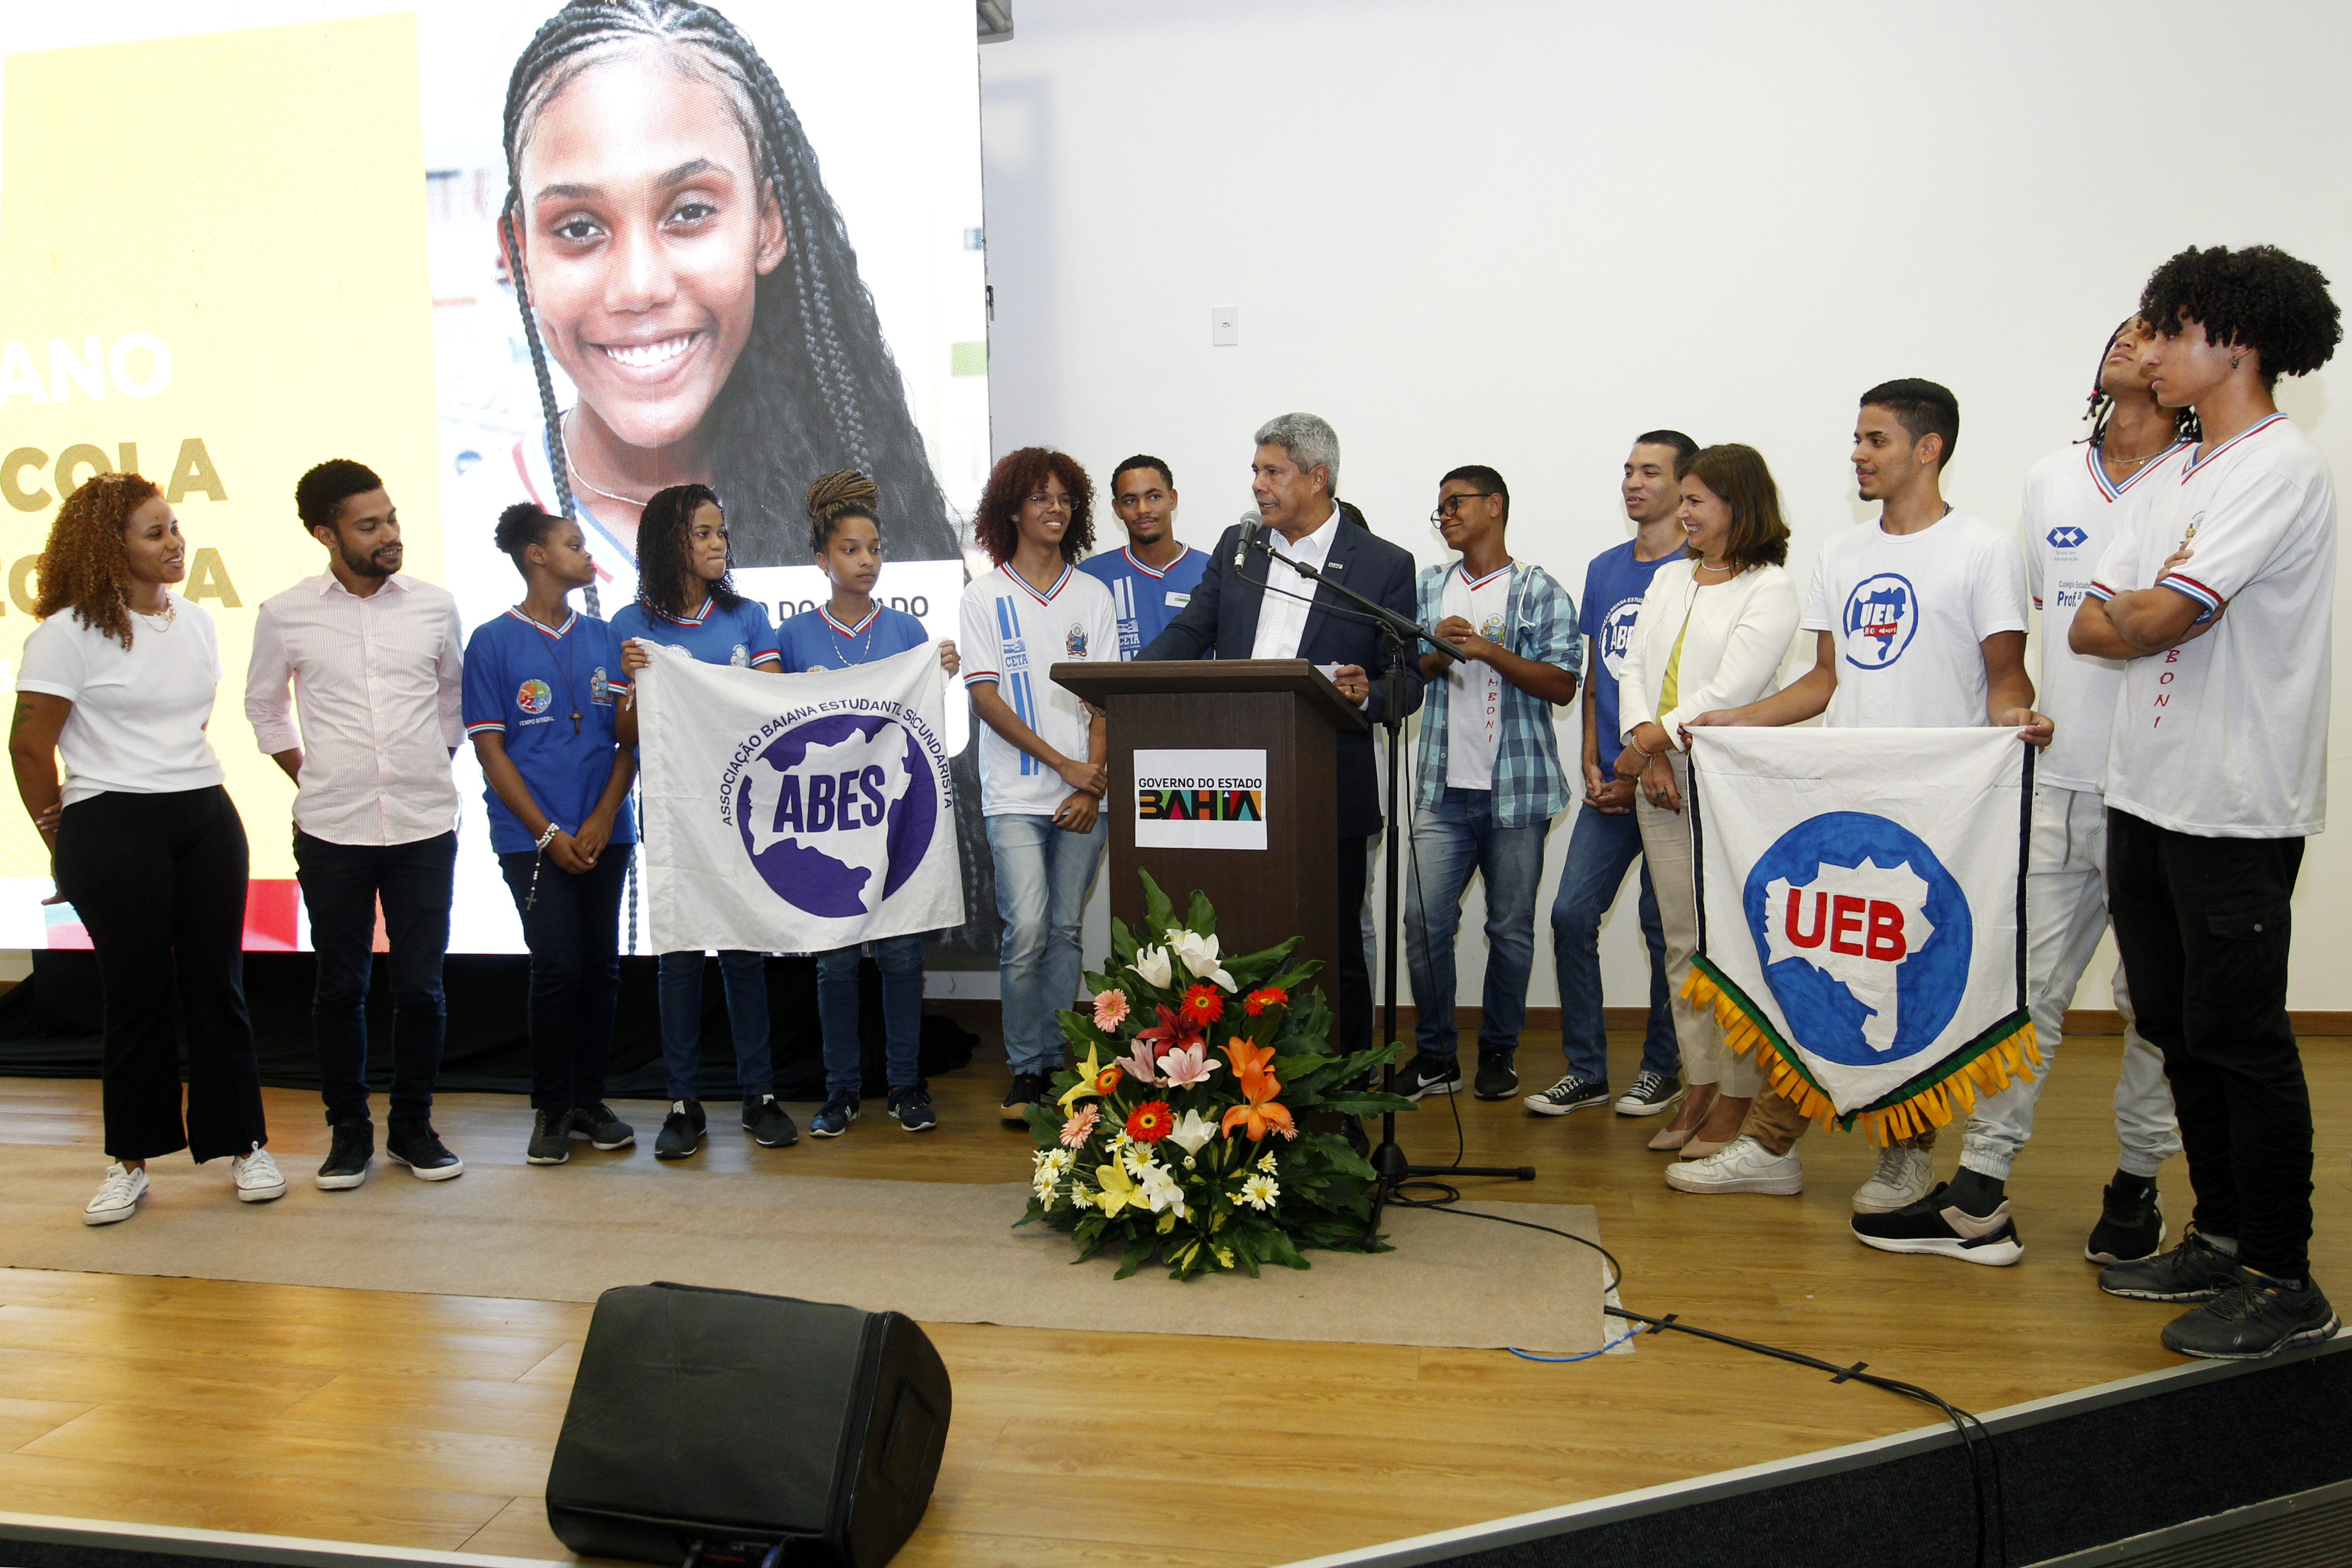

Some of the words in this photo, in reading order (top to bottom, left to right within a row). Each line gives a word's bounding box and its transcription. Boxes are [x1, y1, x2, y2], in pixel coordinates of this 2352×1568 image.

[0, 332, 172, 404] ANO
[2059, 581, 2075, 590] Colégio
[1610, 599, 1627, 613] BAIANA
[1860, 603, 1896, 627] UEB
[1119, 633, 1140, 646] CETA
[1610, 625, 1635, 650] ABE
[1005, 654, 1028, 667] CETA
[519, 719, 535, 727] TEMPO
[536, 716, 555, 724] INTEGRL
[720, 735, 761, 827] ASSOCIAÇÃO
[760, 706, 818, 738] BAIANA
[1139, 778, 1194, 788] GOVERNO
[1198, 778, 1214, 788] DO
[1218, 778, 1262, 788] ESTADO
[772, 764, 886, 833] ABES
[1139, 790, 1262, 821] BAHIA
[1785, 888, 1907, 962] UEB
